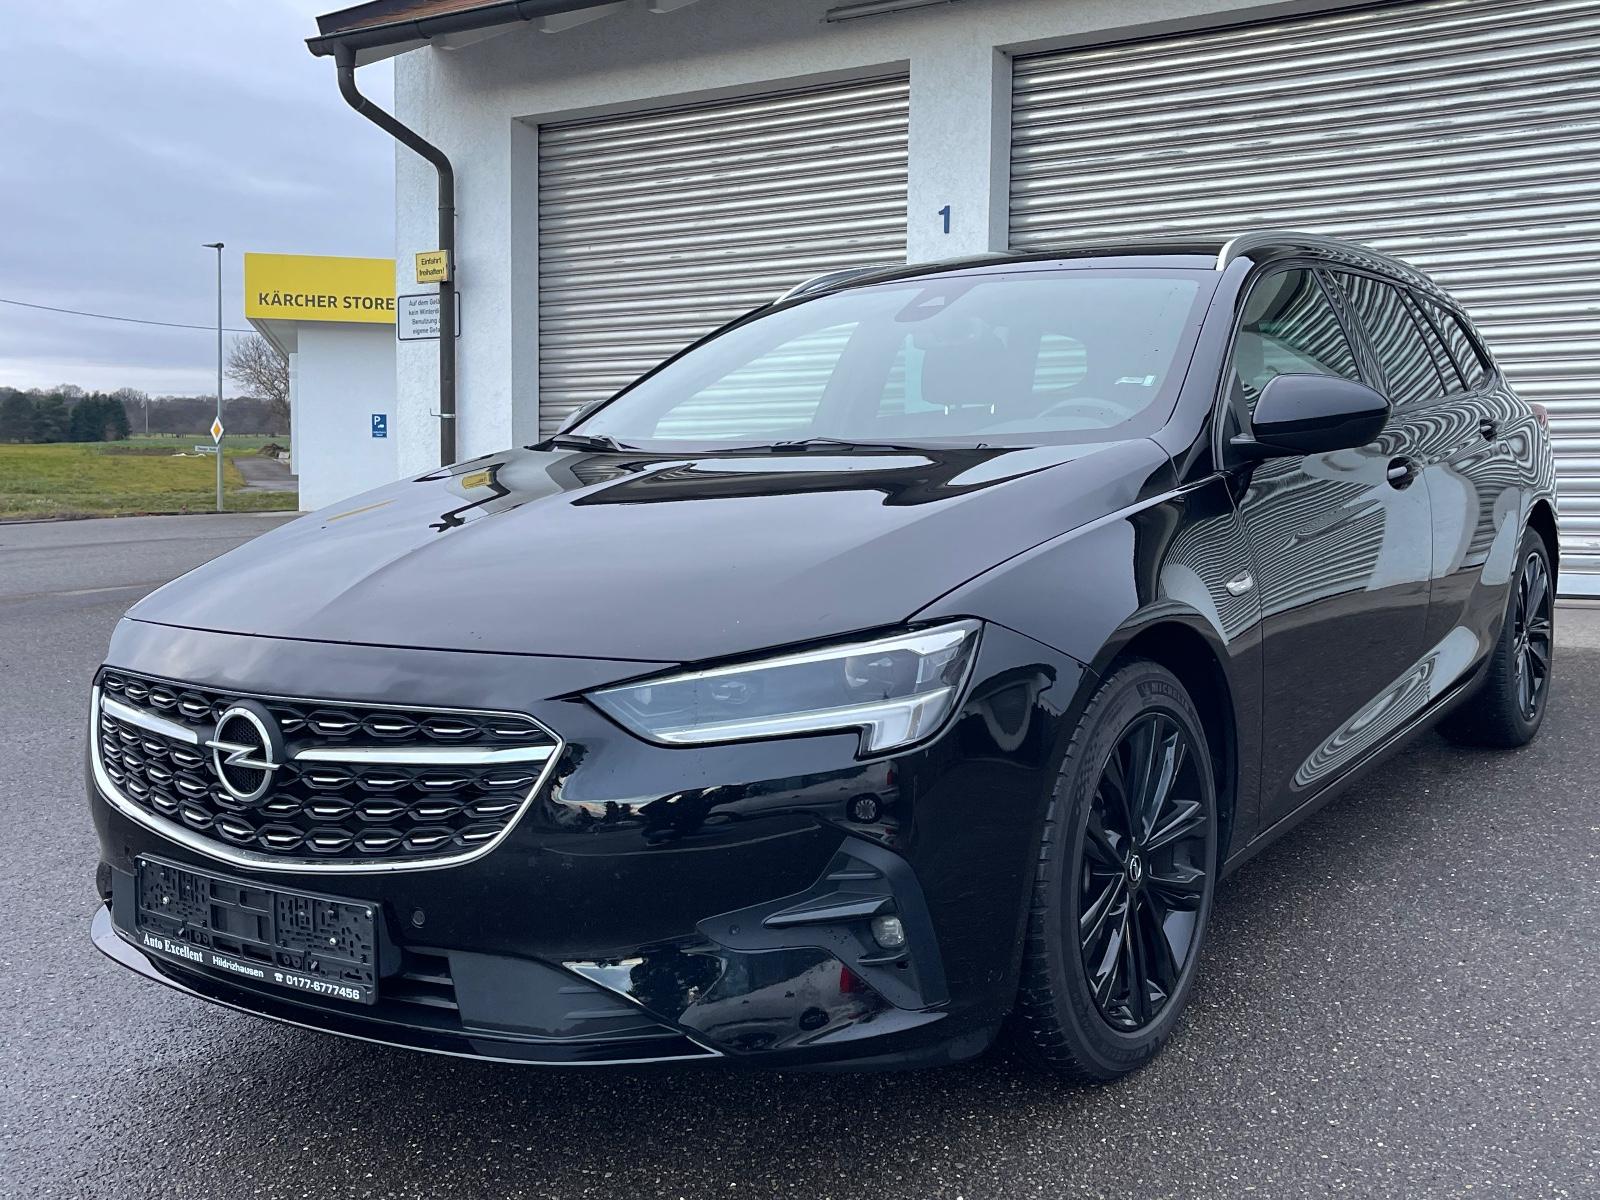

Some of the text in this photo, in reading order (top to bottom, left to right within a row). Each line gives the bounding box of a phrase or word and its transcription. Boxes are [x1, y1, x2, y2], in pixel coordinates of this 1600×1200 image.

[938, 205, 950, 234] 1
[421, 257, 442, 265] Einfahrt
[419, 268, 445, 276] freihalten!
[258, 290, 395, 311] KÄRCHER STORE
[408, 299, 418, 307] Auf
[429, 326, 440, 334] Gefa
[143, 932, 360, 1000] Auto Excellent Hildrizhausen 0177-6777456
